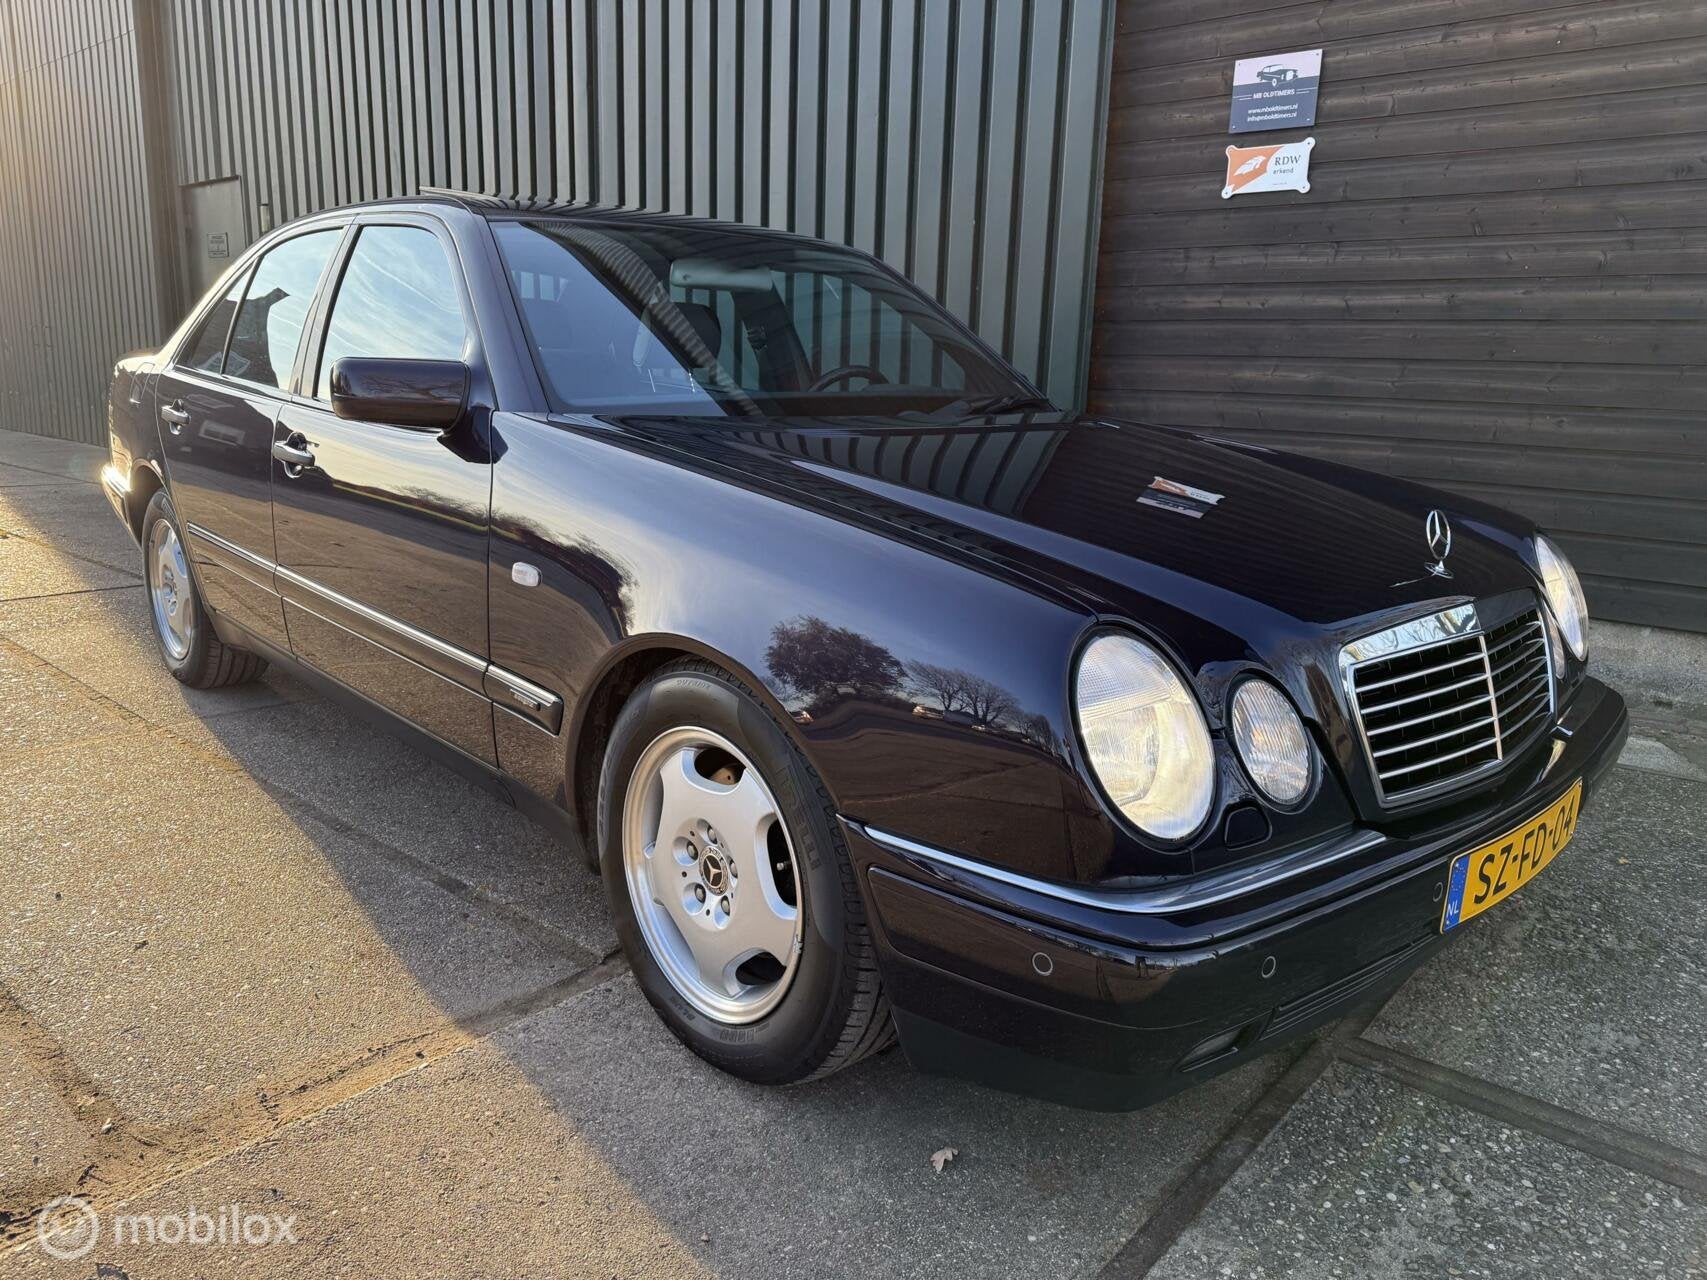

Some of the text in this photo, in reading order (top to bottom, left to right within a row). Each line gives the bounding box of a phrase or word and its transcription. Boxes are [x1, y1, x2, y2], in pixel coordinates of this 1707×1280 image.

[1263, 89, 1296, 98] OLDTIMERS
[1274, 155, 1301, 167] RDW
[1273, 166, 1294, 175] erkend
[1473, 795, 1576, 905] SZ-FD-04
[1446, 902, 1460, 917] NL
